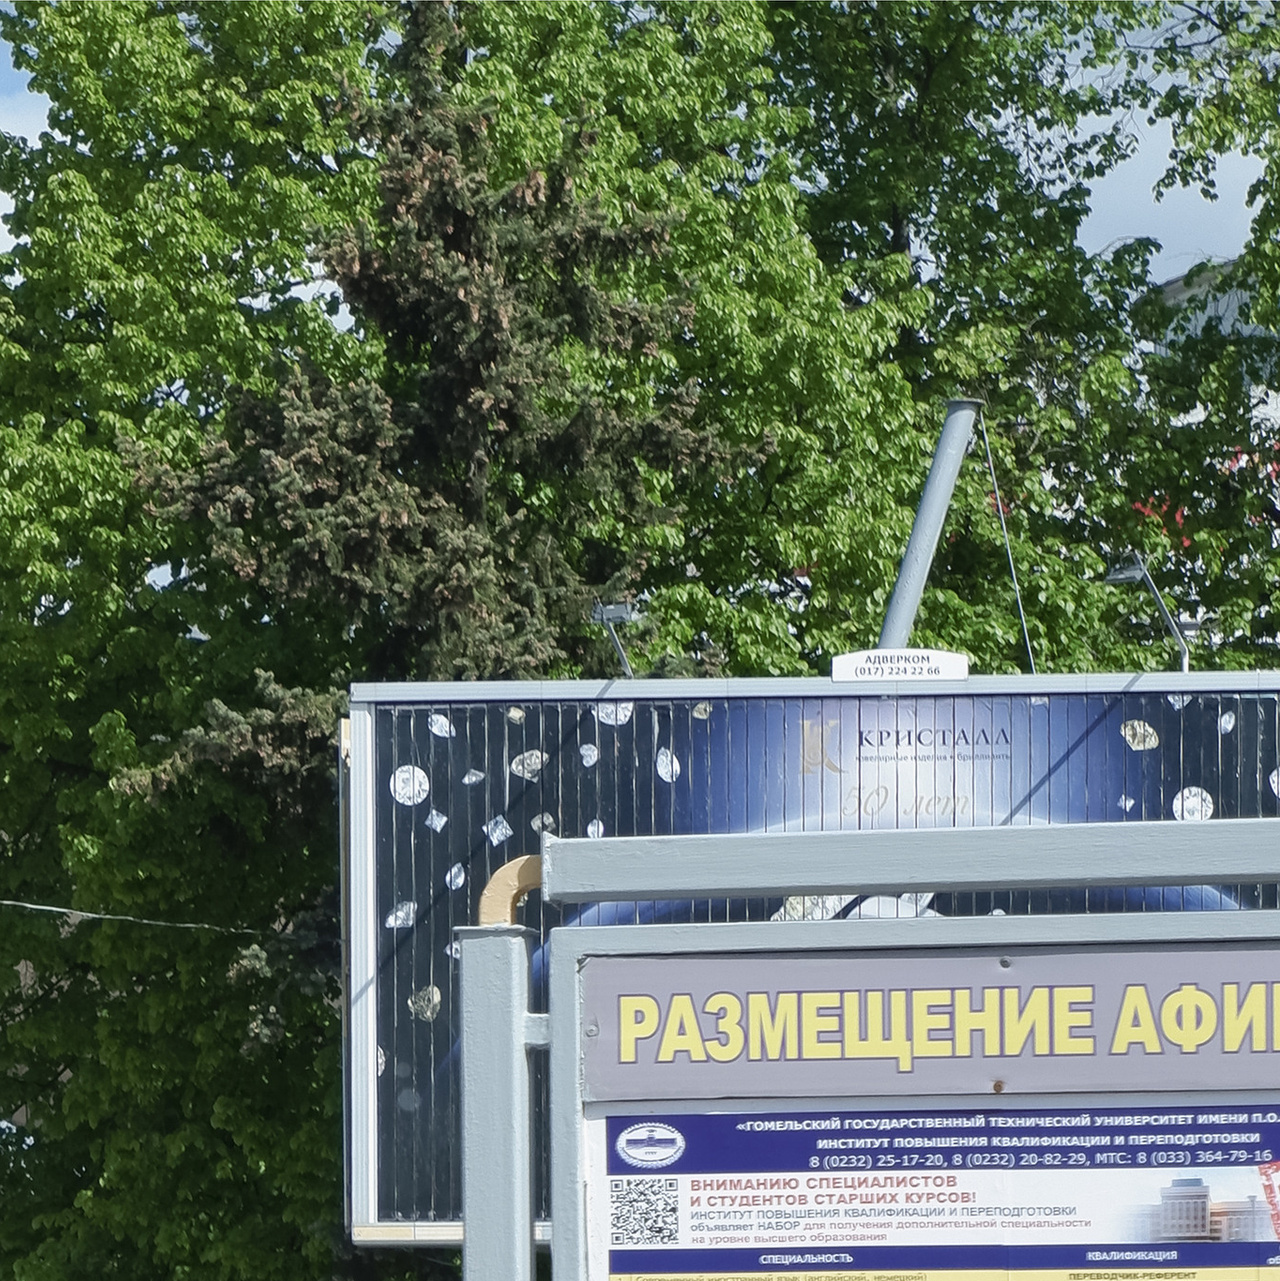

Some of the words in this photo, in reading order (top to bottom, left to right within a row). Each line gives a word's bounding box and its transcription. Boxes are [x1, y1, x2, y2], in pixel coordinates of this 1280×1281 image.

[865, 654, 930, 665] АДВЕРКОМ
[854, 666, 885, 677] (017)
[888, 666, 908, 676] 224
[911, 666, 924, 676] 22
[927, 666, 941, 676] 66
[859, 728, 1011, 748] КРИСТАЛЛ
[618, 984, 1096, 1073] РАЗМЕЩЕНИЕ
[1110, 981, 1280, 1056] АФИ
[843, 1113, 985, 1131] ГОСУДАРСТВЕННЫЙ
[989, 1112, 1092, 1128] ТЕХНИЧЕСКИЙ
[1094, 1114, 1195, 1127] УНИВЕРСИТЕТ
[1197, 1112, 1250, 1125] ИМЕНИ
[816, 1137, 891, 1150] ИНСТИТУТ
[893, 1136, 988, 1149] ПОВЫШЕНИЯ
[990, 1135, 1111, 1149] КВАЛИФИКАЦИИ
[1114, 1135, 1125, 1146] И
[1128, 1132, 1261, 1147] ПЕРЕПОДГОТОВКИ
[808, 1156, 820, 1168] 8
[824, 1154, 873, 1169] (0232)
[876, 1154, 948, 1170] 25-17-20,
[952, 1153, 963, 1165] 8
[968, 1152, 1016, 1168] (0232)
[1020, 1152, 1090, 1167] 20-82-29,
[1095, 1151, 1133, 1165] МТС:
[1138, 1151, 1148, 1164] 8
[1152, 1150, 1192, 1165] (033)
[1197, 1149, 1273, 1163] 364-79-16
[690, 1177, 800, 1192] ВНИМАНИЮ
[806, 1174, 957, 1191] СПЕЦИАЛИСТОВ
[690, 1195, 702, 1207] И
[707, 1193, 809, 1208] СТУДЕНТОВ
[814, 1192, 901, 1206] СТАРШИХ
[905, 1190, 977, 1205] КУРСОВ!
[690, 1208, 754, 1220] ИНСТИТУТ
[757, 1207, 841, 1219] ПОВЫШЕНИЯ
[844, 1206, 946, 1219] КВАЛИФИКАЦИИ
[949, 1206, 958, 1216] И
[961, 1205, 1077, 1218] ПЕРЕПОДГОТОВКИ
[690, 1221, 755, 1232] объявляет
[758, 1219, 801, 1230] НАБОР
[804, 1221, 826, 1231] для
[829, 1219, 893, 1231] получения
[896, 1218, 997, 1230] дополнительной
[1001, 1218, 1092, 1230] специальности
[692, 1234, 707, 1243] на
[709, 1234, 751, 1246] уровне
[754, 1232, 806, 1243] высшего
[809, 1231, 888, 1243] образования
[758, 1253, 854, 1266] СПЕЦИАЛЬНОСТЬ
[1086, 1250, 1178, 1263] КВАЛИФИКАЦИЯ
